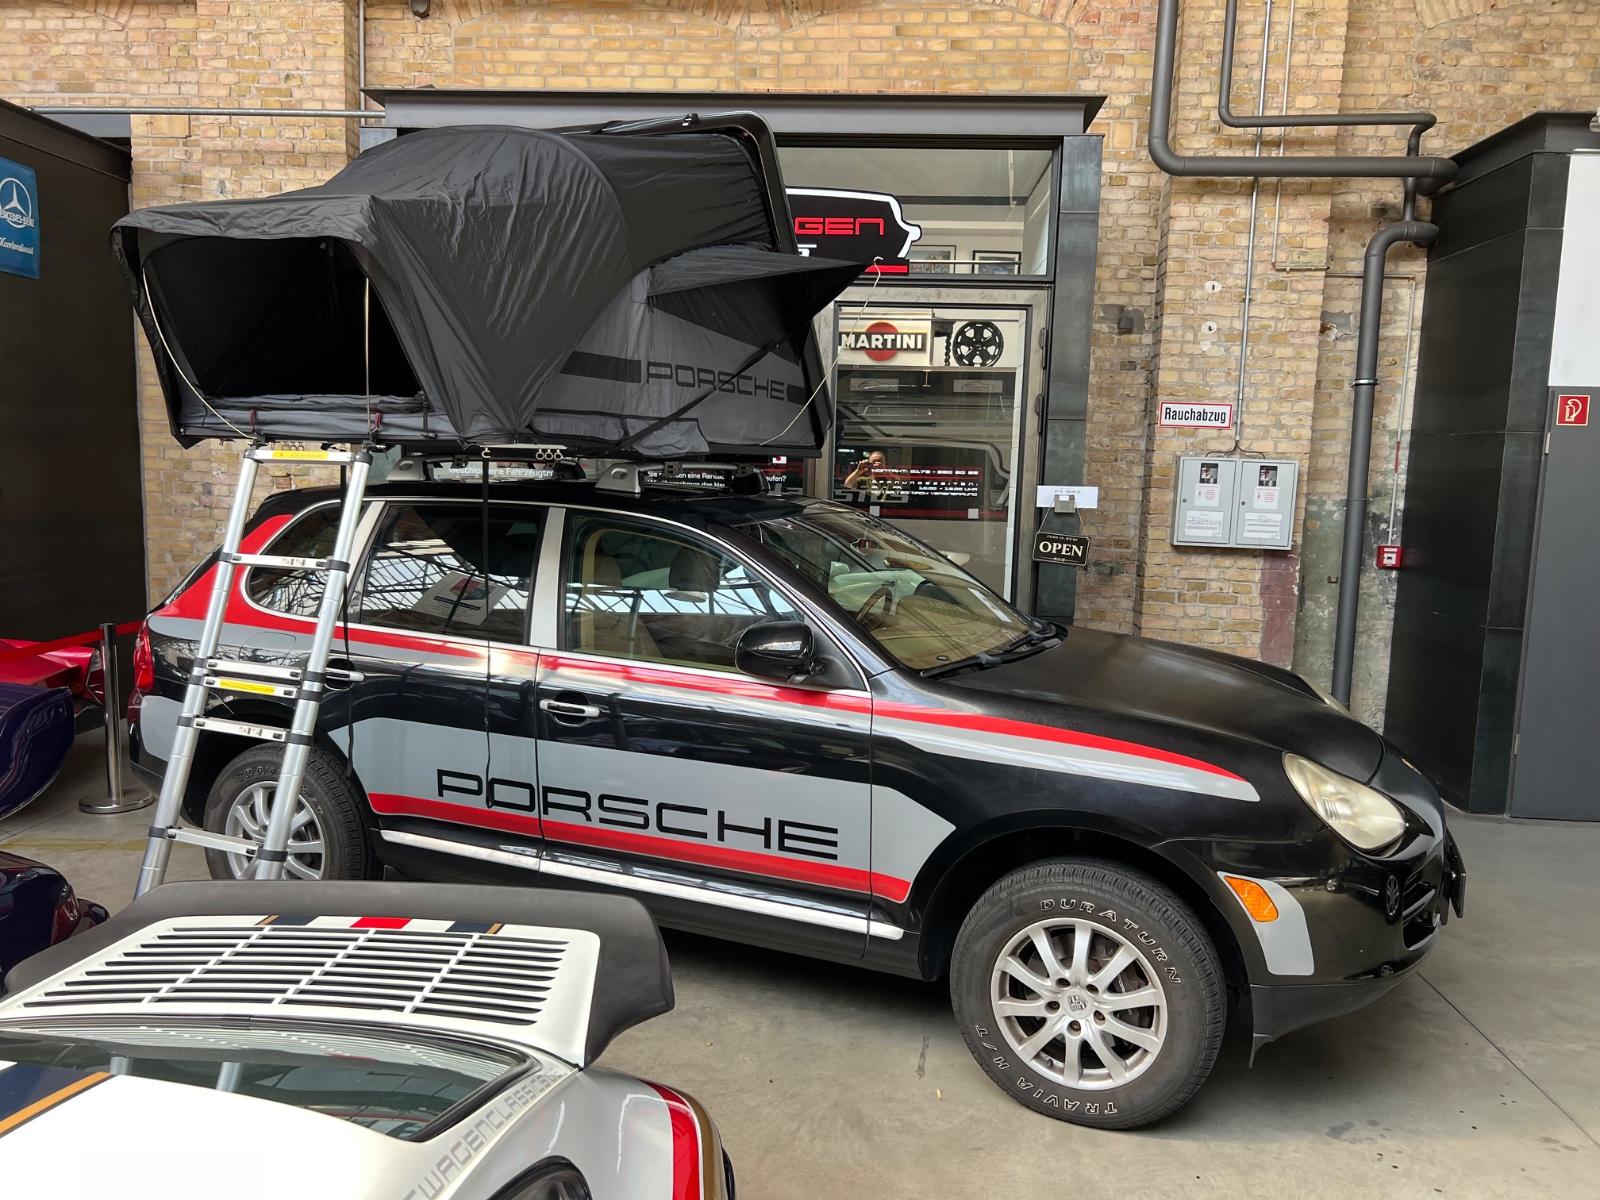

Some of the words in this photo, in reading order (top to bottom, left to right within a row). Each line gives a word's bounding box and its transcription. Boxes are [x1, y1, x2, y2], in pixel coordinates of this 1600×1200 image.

[793, 217, 885, 236] GEN
[841, 333, 923, 350] MARTINI
[646, 361, 786, 401] PORSCHE
[1164, 407, 1227, 424] Rauchabzug
[1039, 541, 1084, 557] OPEN
[436, 769, 839, 861] PORSCHE
[1040, 898, 1183, 984] DURATURN
[975, 1024, 1010, 1071] H/T
[1016, 1076, 1118, 1115] TRAVIA
